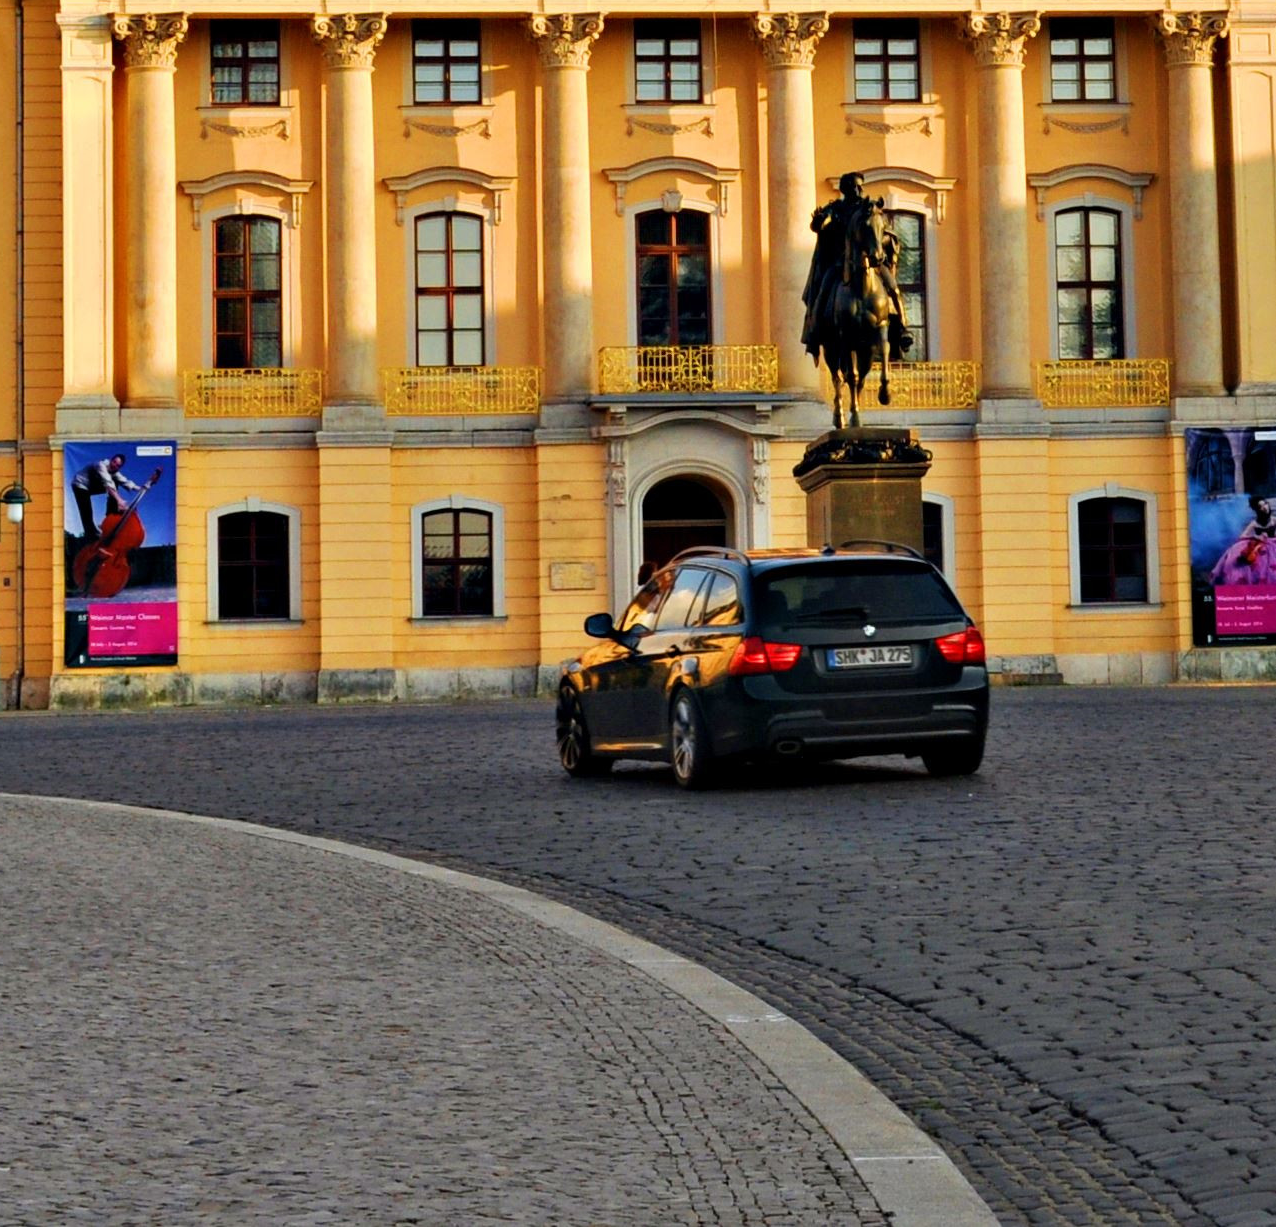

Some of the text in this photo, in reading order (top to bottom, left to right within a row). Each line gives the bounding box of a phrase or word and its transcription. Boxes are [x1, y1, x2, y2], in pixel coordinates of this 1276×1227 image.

[835, 647, 911, 664] SHK JA 275
